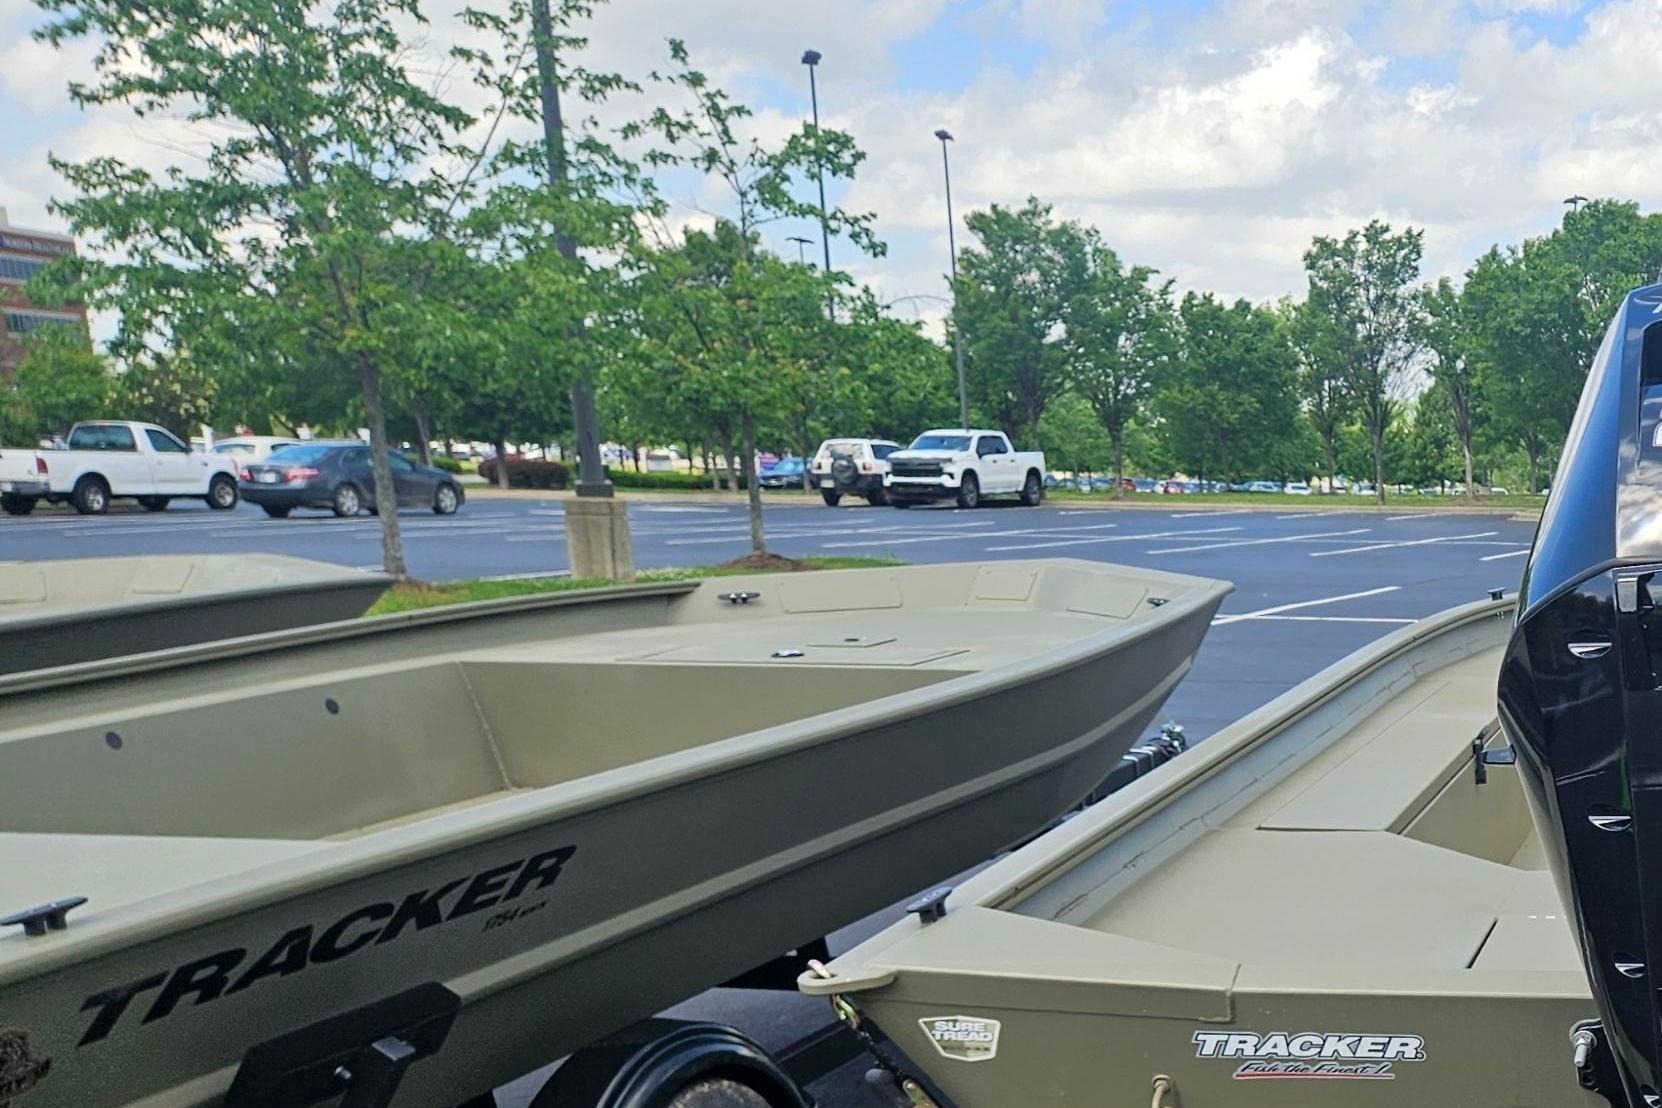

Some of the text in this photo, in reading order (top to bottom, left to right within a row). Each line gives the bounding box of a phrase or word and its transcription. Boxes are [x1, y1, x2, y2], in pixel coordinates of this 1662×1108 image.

[77, 845, 578, 1047] TRACKER
[934, 1020, 987, 1031] SURE
[931, 1030, 993, 1041] TREAD
[1195, 1033, 1424, 1060] TRACKER
[1241, 1061, 1279, 1073] Fish
[1281, 1062, 1311, 1074] the
